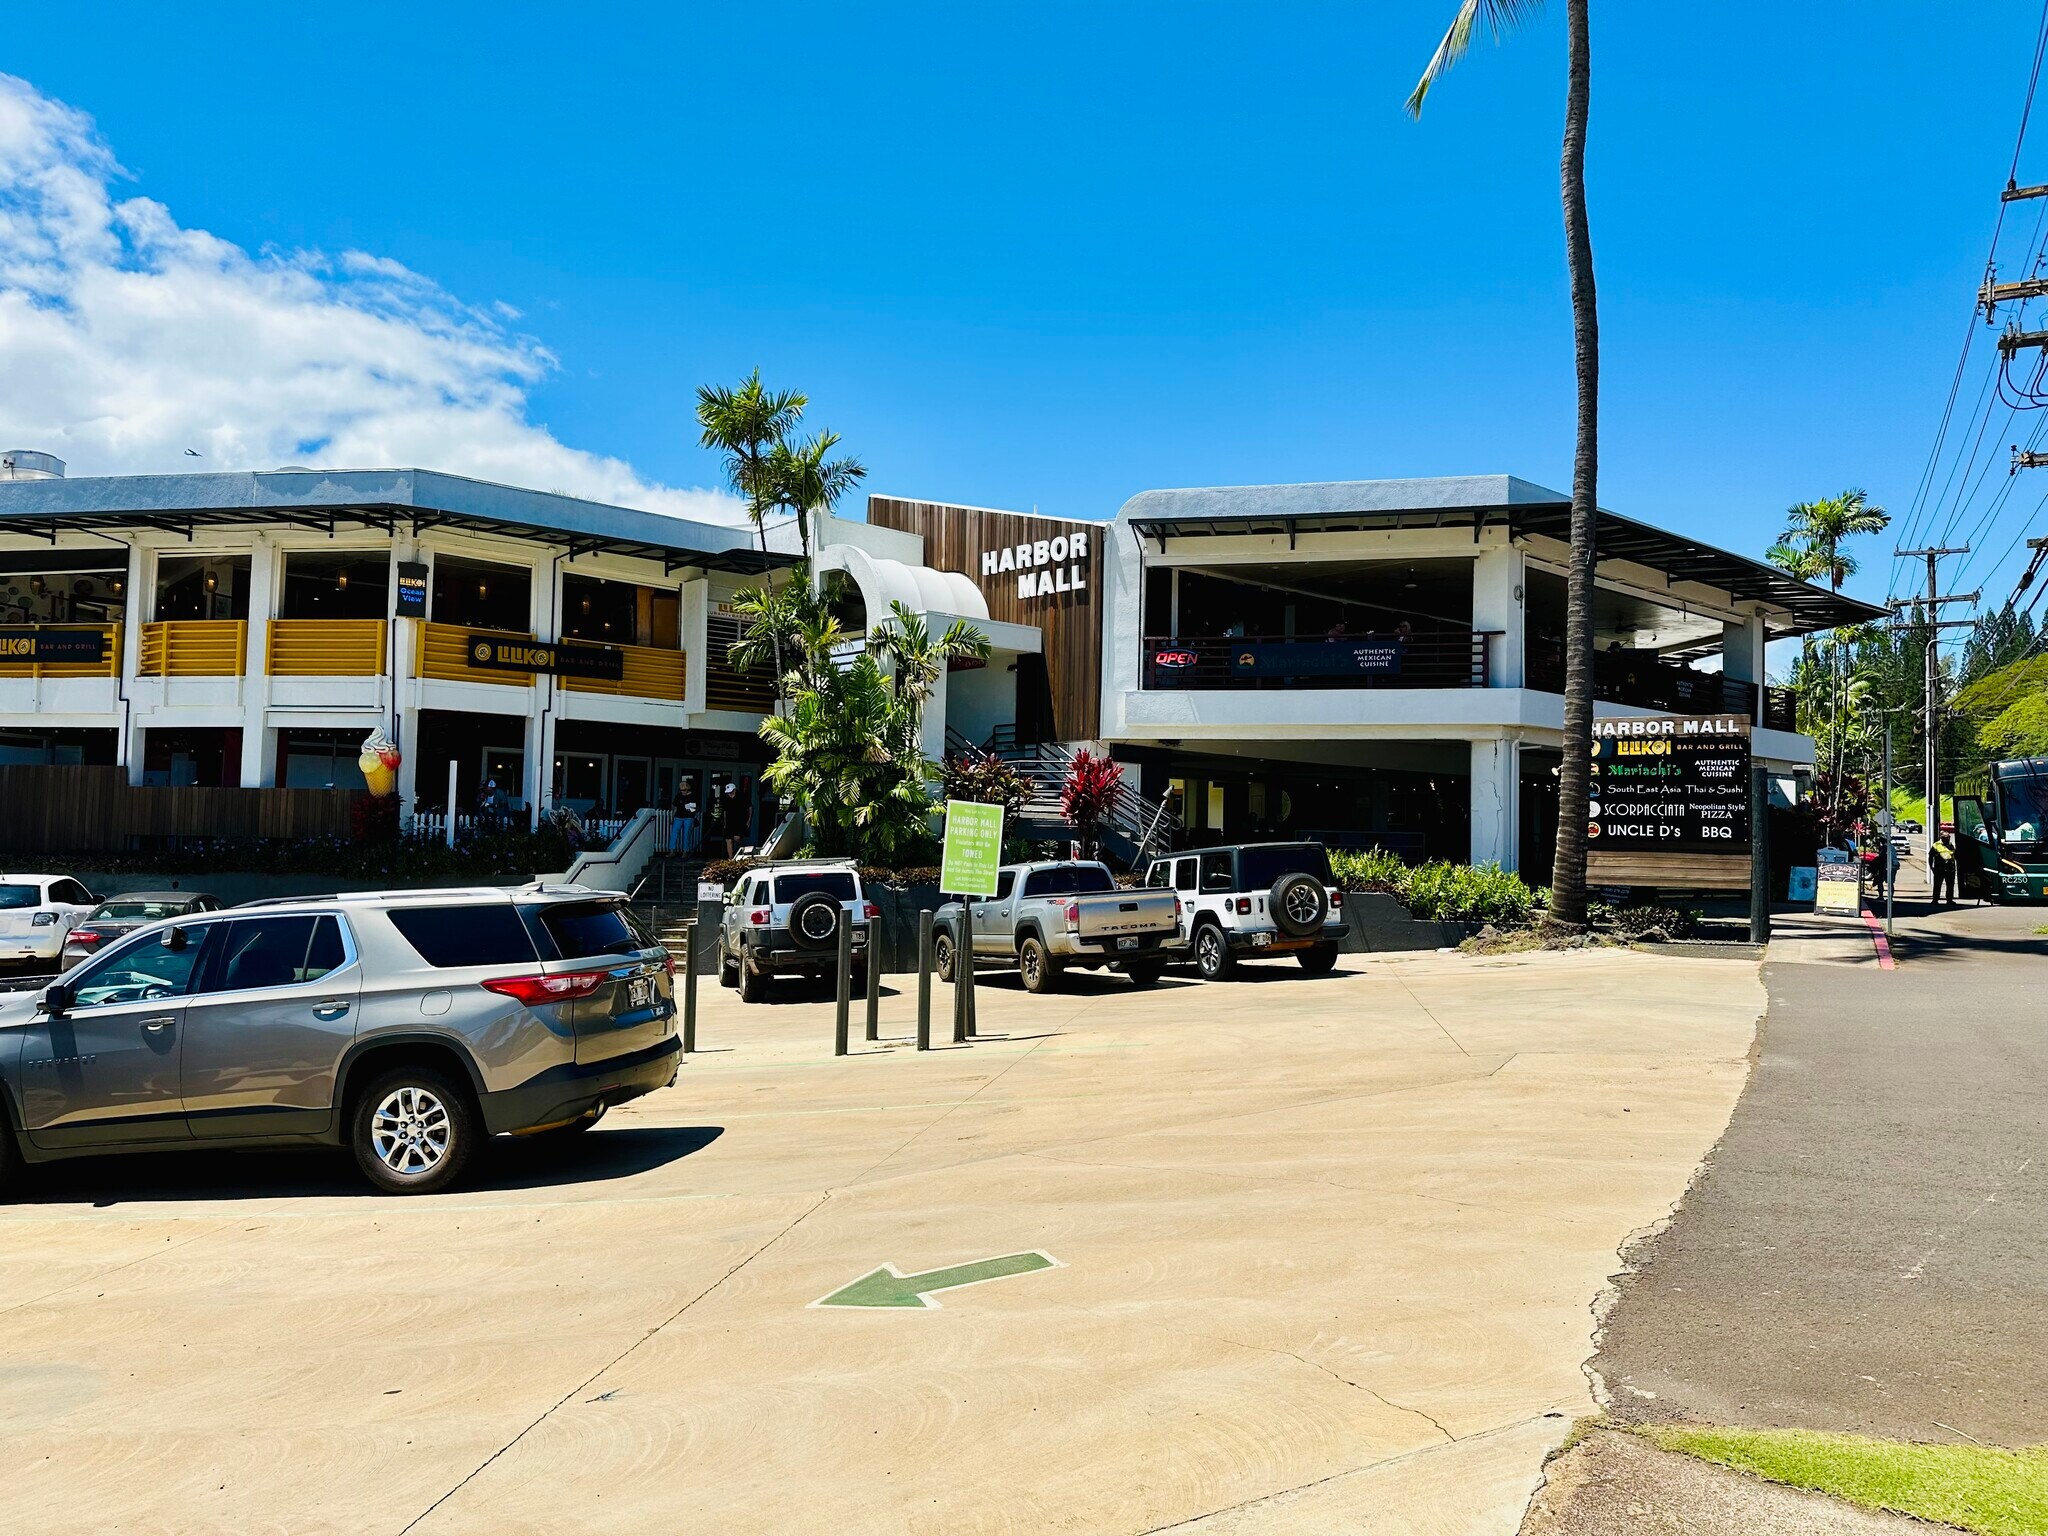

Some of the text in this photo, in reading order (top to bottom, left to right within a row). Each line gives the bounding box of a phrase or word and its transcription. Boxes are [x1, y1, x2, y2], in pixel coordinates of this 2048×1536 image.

[982, 532, 1087, 576] HARBOR
[1017, 565, 1086, 599] MALL
[400, 587, 425, 596] Ocean
[402, 594, 422, 602] View
[1155, 652, 1199, 664] OPEN
[1592, 720, 1739, 735] HARBOR MALL
[1608, 761, 1682, 776] Mariachi's
[1607, 784, 1635, 794] South
[1636, 785, 1658, 794] East
[1660, 785, 1682, 794] Asia
[1685, 784, 1707, 794] Thai
[1716, 784, 1743, 794] Sushi
[1604, 803, 1685, 817] SCORPACCIATA
[1689, 803, 1746, 811] Neopolitan Style
[1701, 811, 1733, 819] PIZZA
[952, 816, 996, 828] HARBOR MALL
[950, 827, 997, 839] PARKING ONLY
[1608, 824, 1681, 837] UNCLE D's
[1701, 826, 1733, 839] BBQ
[962, 849, 982, 859] TOWED
[1102, 922, 1157, 931] TACOMA
